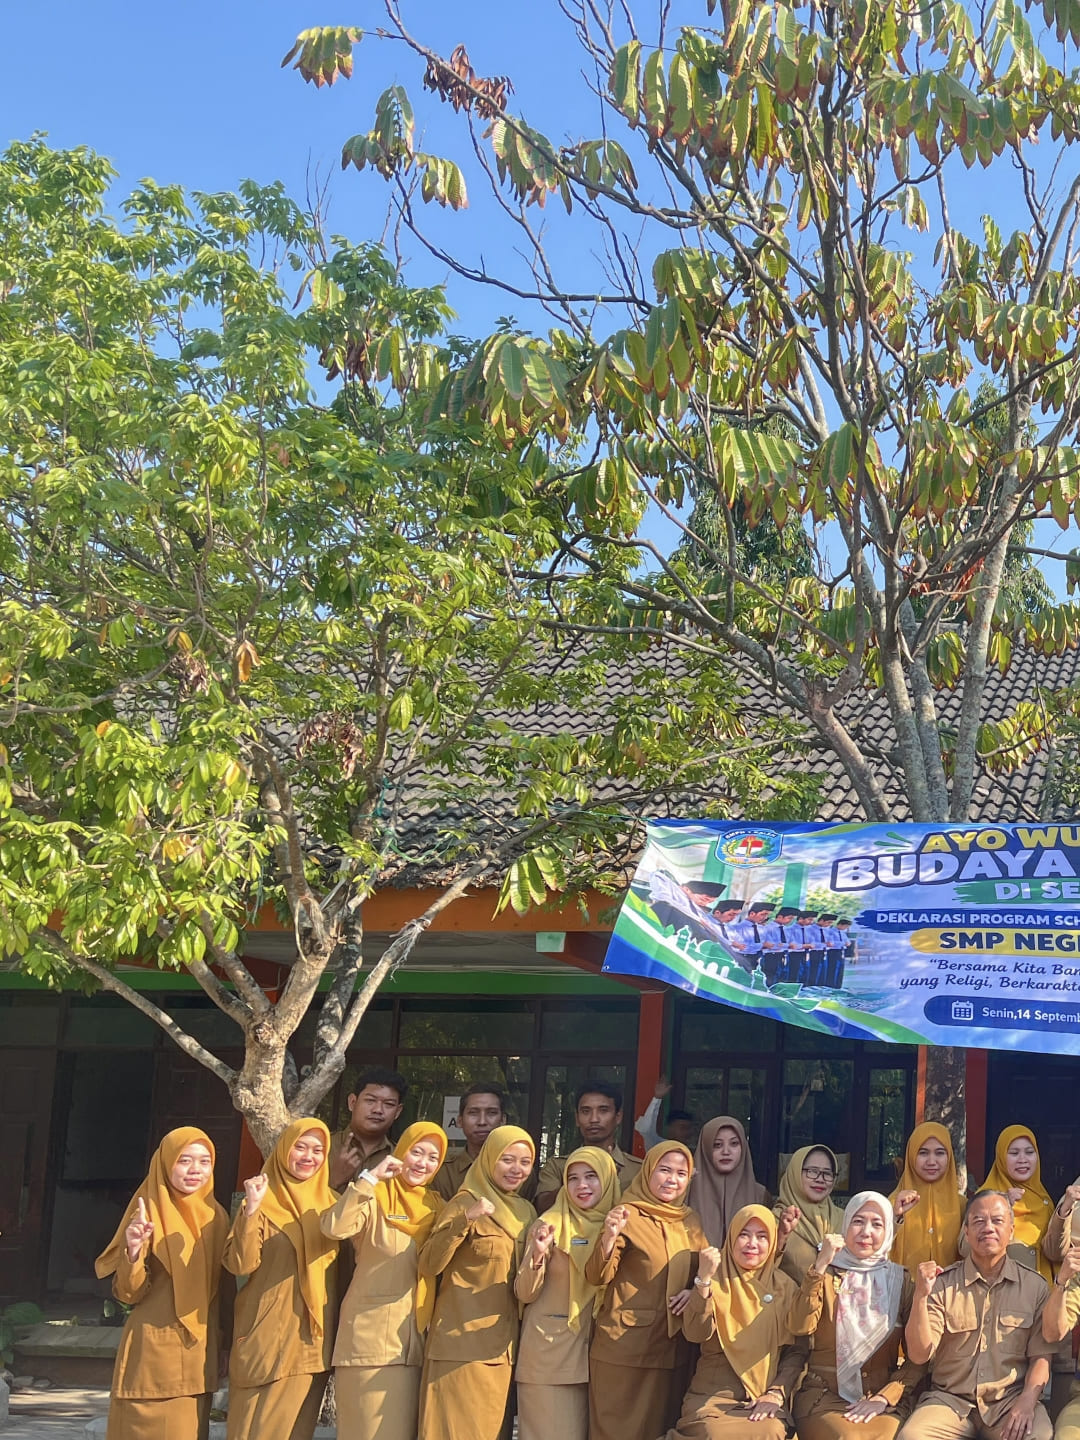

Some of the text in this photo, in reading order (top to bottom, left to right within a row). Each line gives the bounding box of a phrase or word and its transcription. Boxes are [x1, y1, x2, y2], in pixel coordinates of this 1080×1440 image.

[922, 829, 1006, 853] AYO
[836, 849, 1076, 889] BUDAYA
[995, 882, 1030, 900] DI
[876, 912, 965, 924] DEKLARASI
[970, 914, 1050, 926] PROGRAM
[939, 932, 1004, 950] SMP
[1013, 962, 1047, 974] Kita
[900, 976, 939, 990] yang
[945, 974, 993, 990] Religi,
